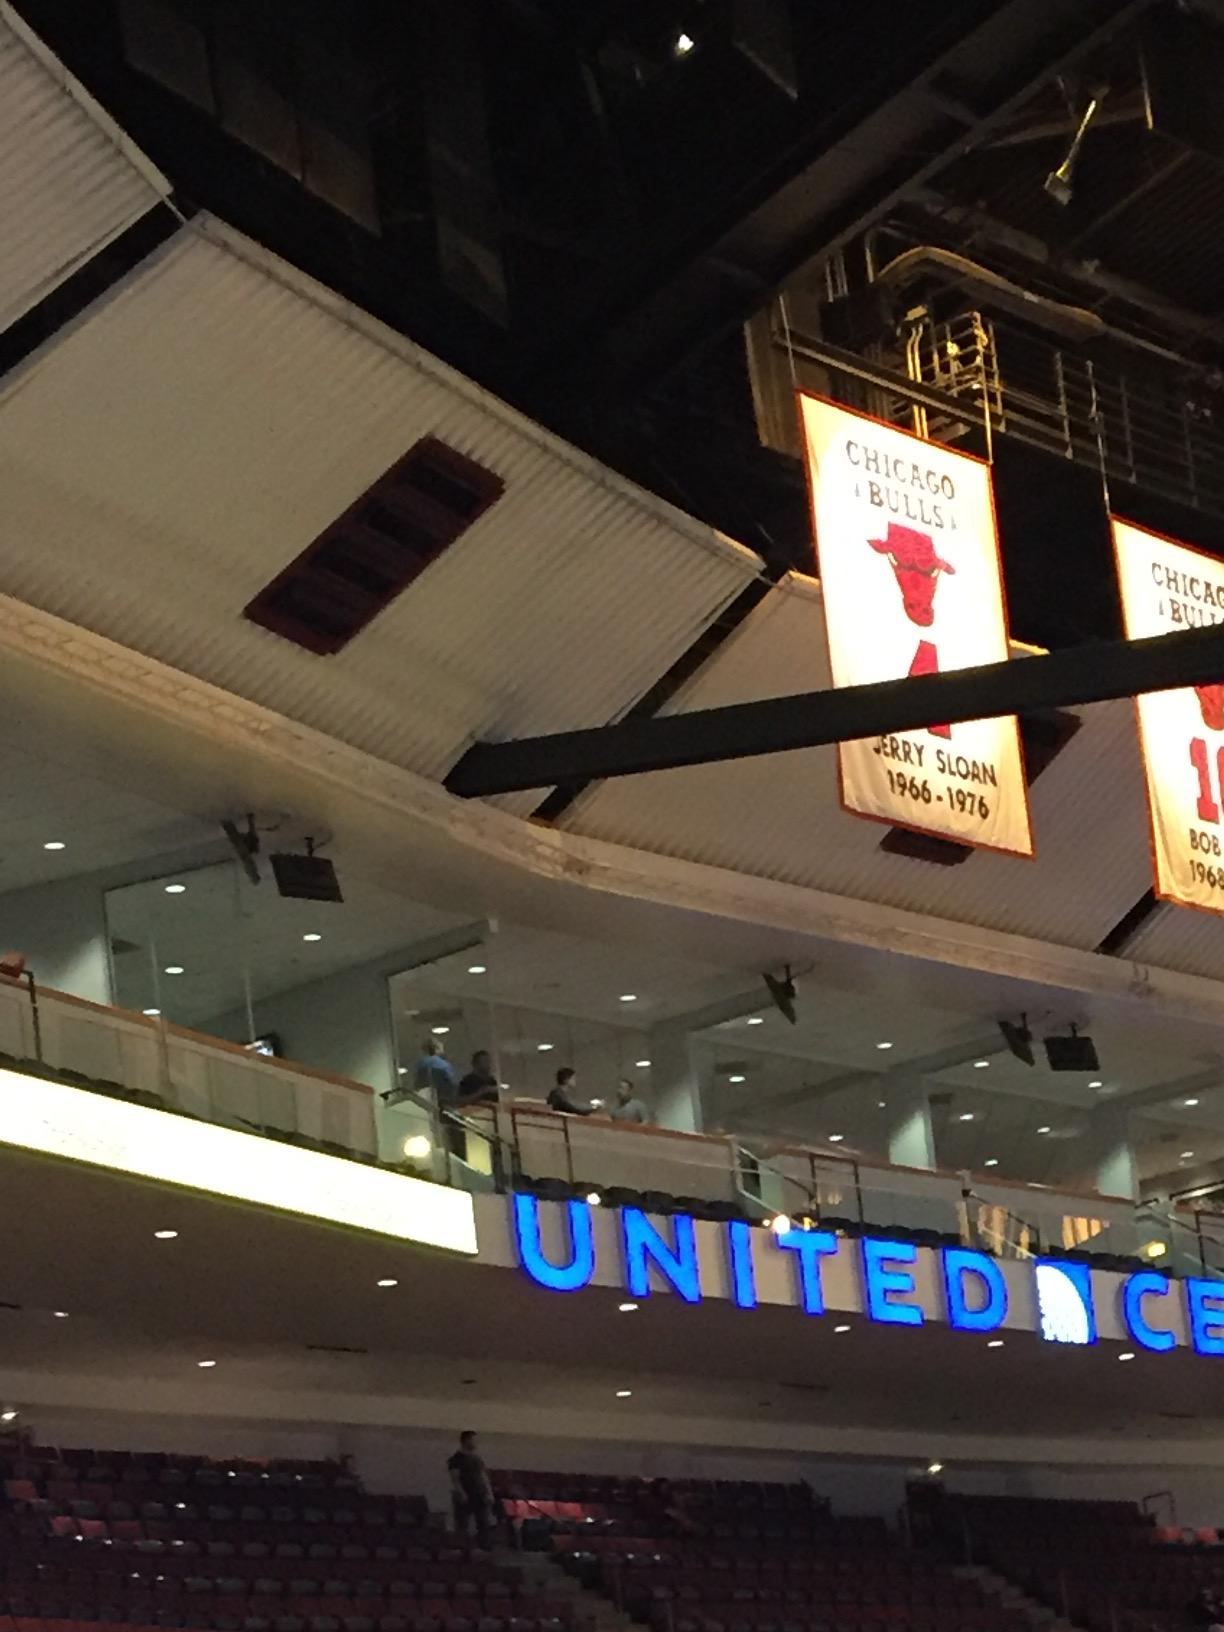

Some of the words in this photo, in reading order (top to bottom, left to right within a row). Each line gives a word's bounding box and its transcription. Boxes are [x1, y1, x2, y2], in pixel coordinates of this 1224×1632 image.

[845, 439, 956, 500] CHICAGO
[869, 480, 945, 530] BULLS
[872, 732, 926, 769] JERRY
[936, 748, 998, 788] SLOAN
[886, 769, 991, 821] 1966-1976
[1189, 827, 1222, 857] BOB
[511, 1192, 1009, 1333] UNITED
